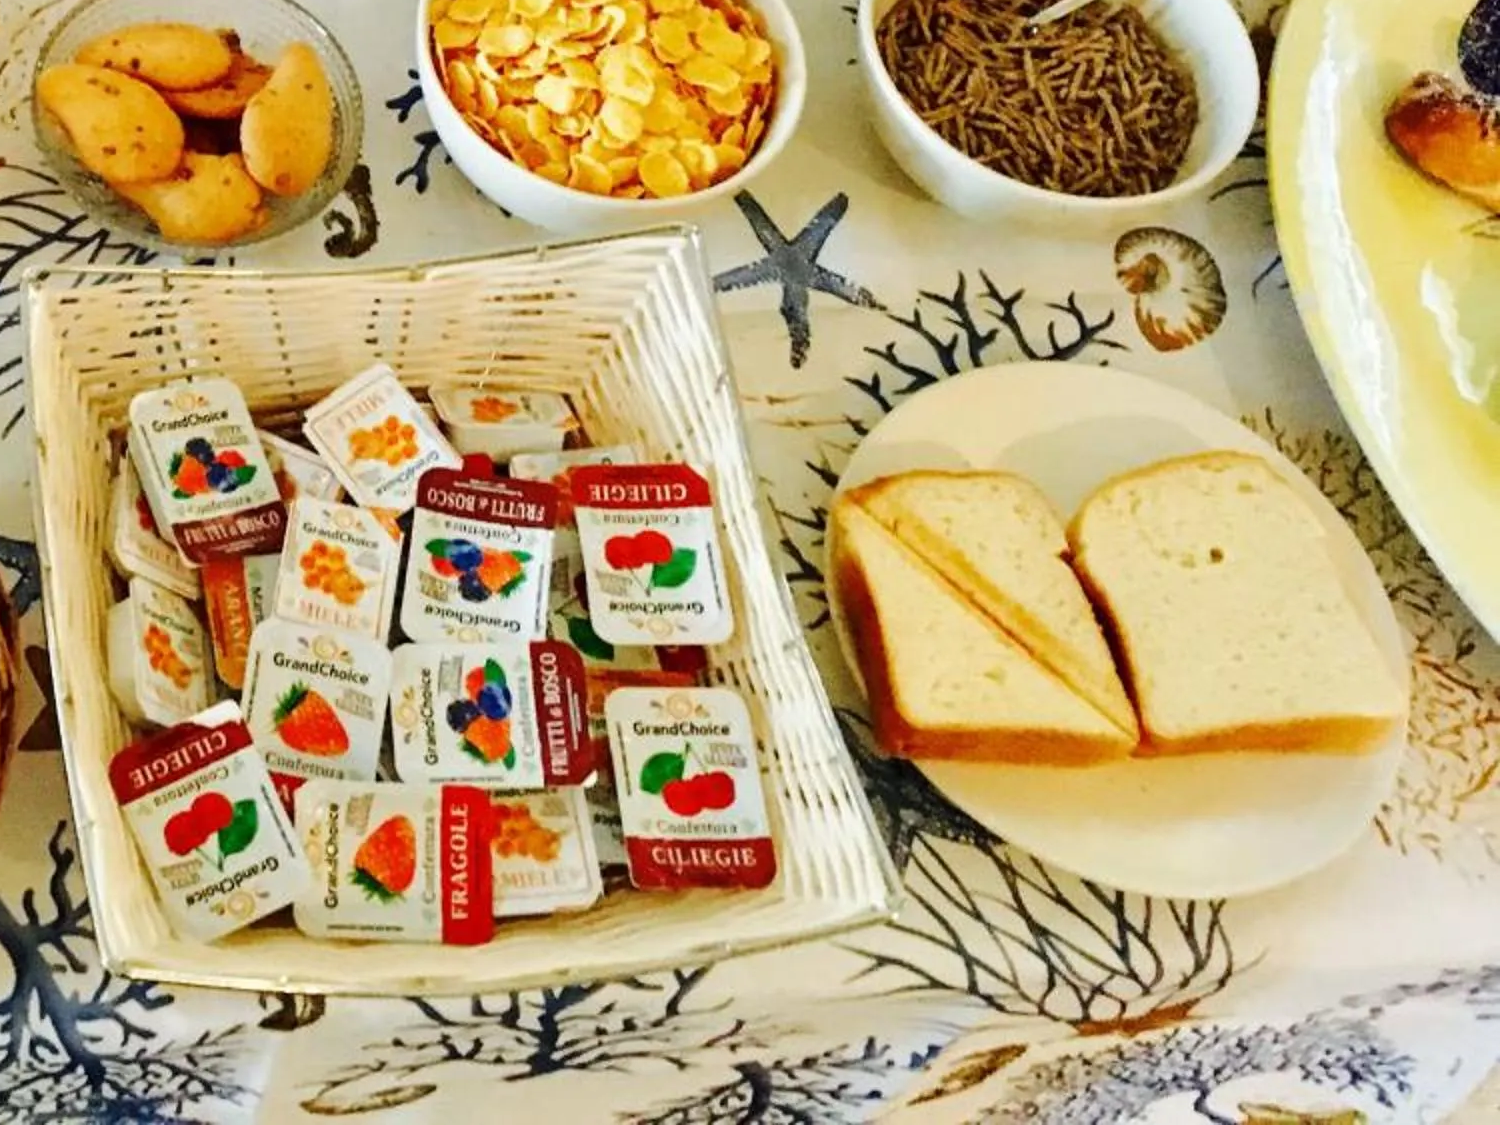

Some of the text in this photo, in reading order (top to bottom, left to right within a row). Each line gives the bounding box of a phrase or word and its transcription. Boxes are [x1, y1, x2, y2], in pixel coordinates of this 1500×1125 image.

[152, 409, 229, 433] GrandChoice
[427, 488, 475, 513] BOSCO
[589, 483, 687, 502] CILIEGIE
[491, 493, 545, 522] FRUTTI
[302, 522, 380, 550] GrandChoice
[444, 520, 523, 544] Confettura
[424, 605, 521, 633] GrandChoice
[610, 601, 705, 614] GrandChoice
[273, 652, 370, 684] GrandChoice
[539, 652, 561, 704] BOSCO
[423, 668, 439, 766] GrandChoice
[632, 720, 731, 737] GrandChoice
[129, 731, 227, 789] CILIEGIE
[549, 719, 568, 777] FRUTTI
[265, 751, 345, 780] Confettura
[153, 766, 230, 808] Confettura
[324, 802, 339, 908] GrandChoice
[450, 802, 469, 921] FRAGOLE
[651, 847, 757, 868] CILIEGIE
[186, 856, 279, 908] GrandChoice
